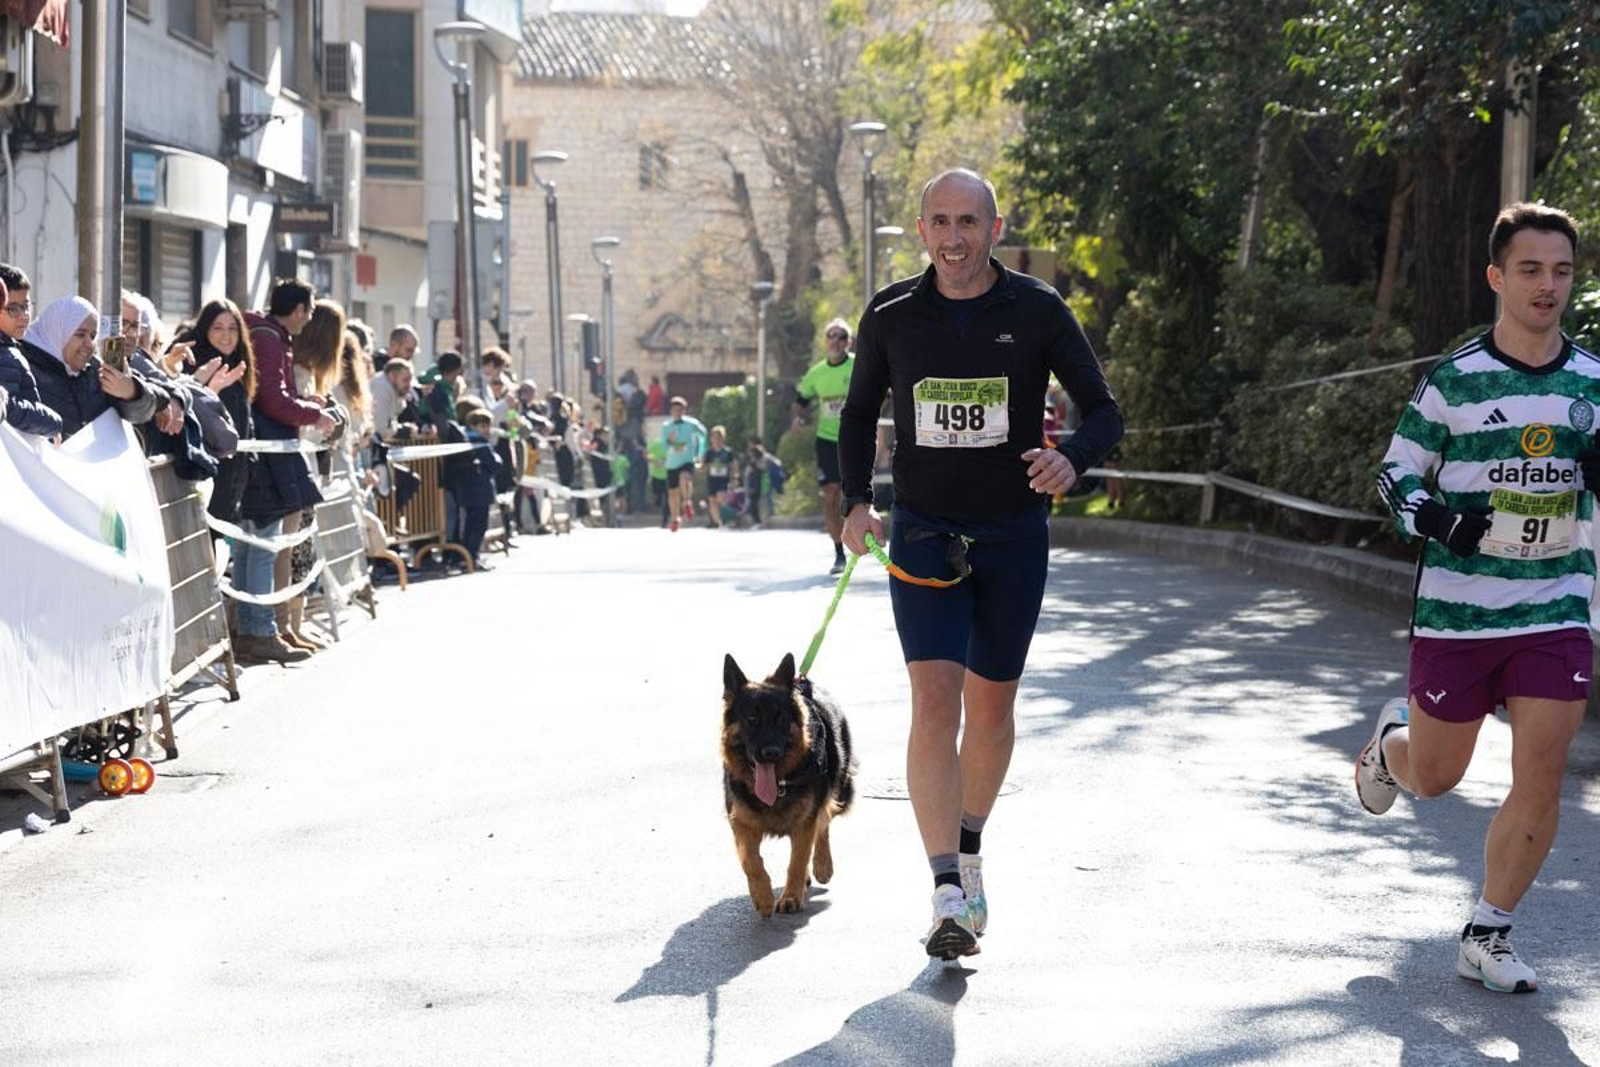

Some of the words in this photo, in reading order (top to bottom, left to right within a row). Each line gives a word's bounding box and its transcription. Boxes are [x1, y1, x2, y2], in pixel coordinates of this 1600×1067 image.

[943, 382, 957, 390] JUAN
[959, 382, 977, 391] BOSCO
[950, 392, 973, 400] POPULAR
[934, 403, 985, 431] 498
[1511, 491, 1522, 502] SAN
[1526, 494, 1541, 504] JUAN
[1504, 501, 1529, 514] CARRERA
[1531, 504, 1554, 514] POPULAR
[1521, 518, 1549, 544] 91
